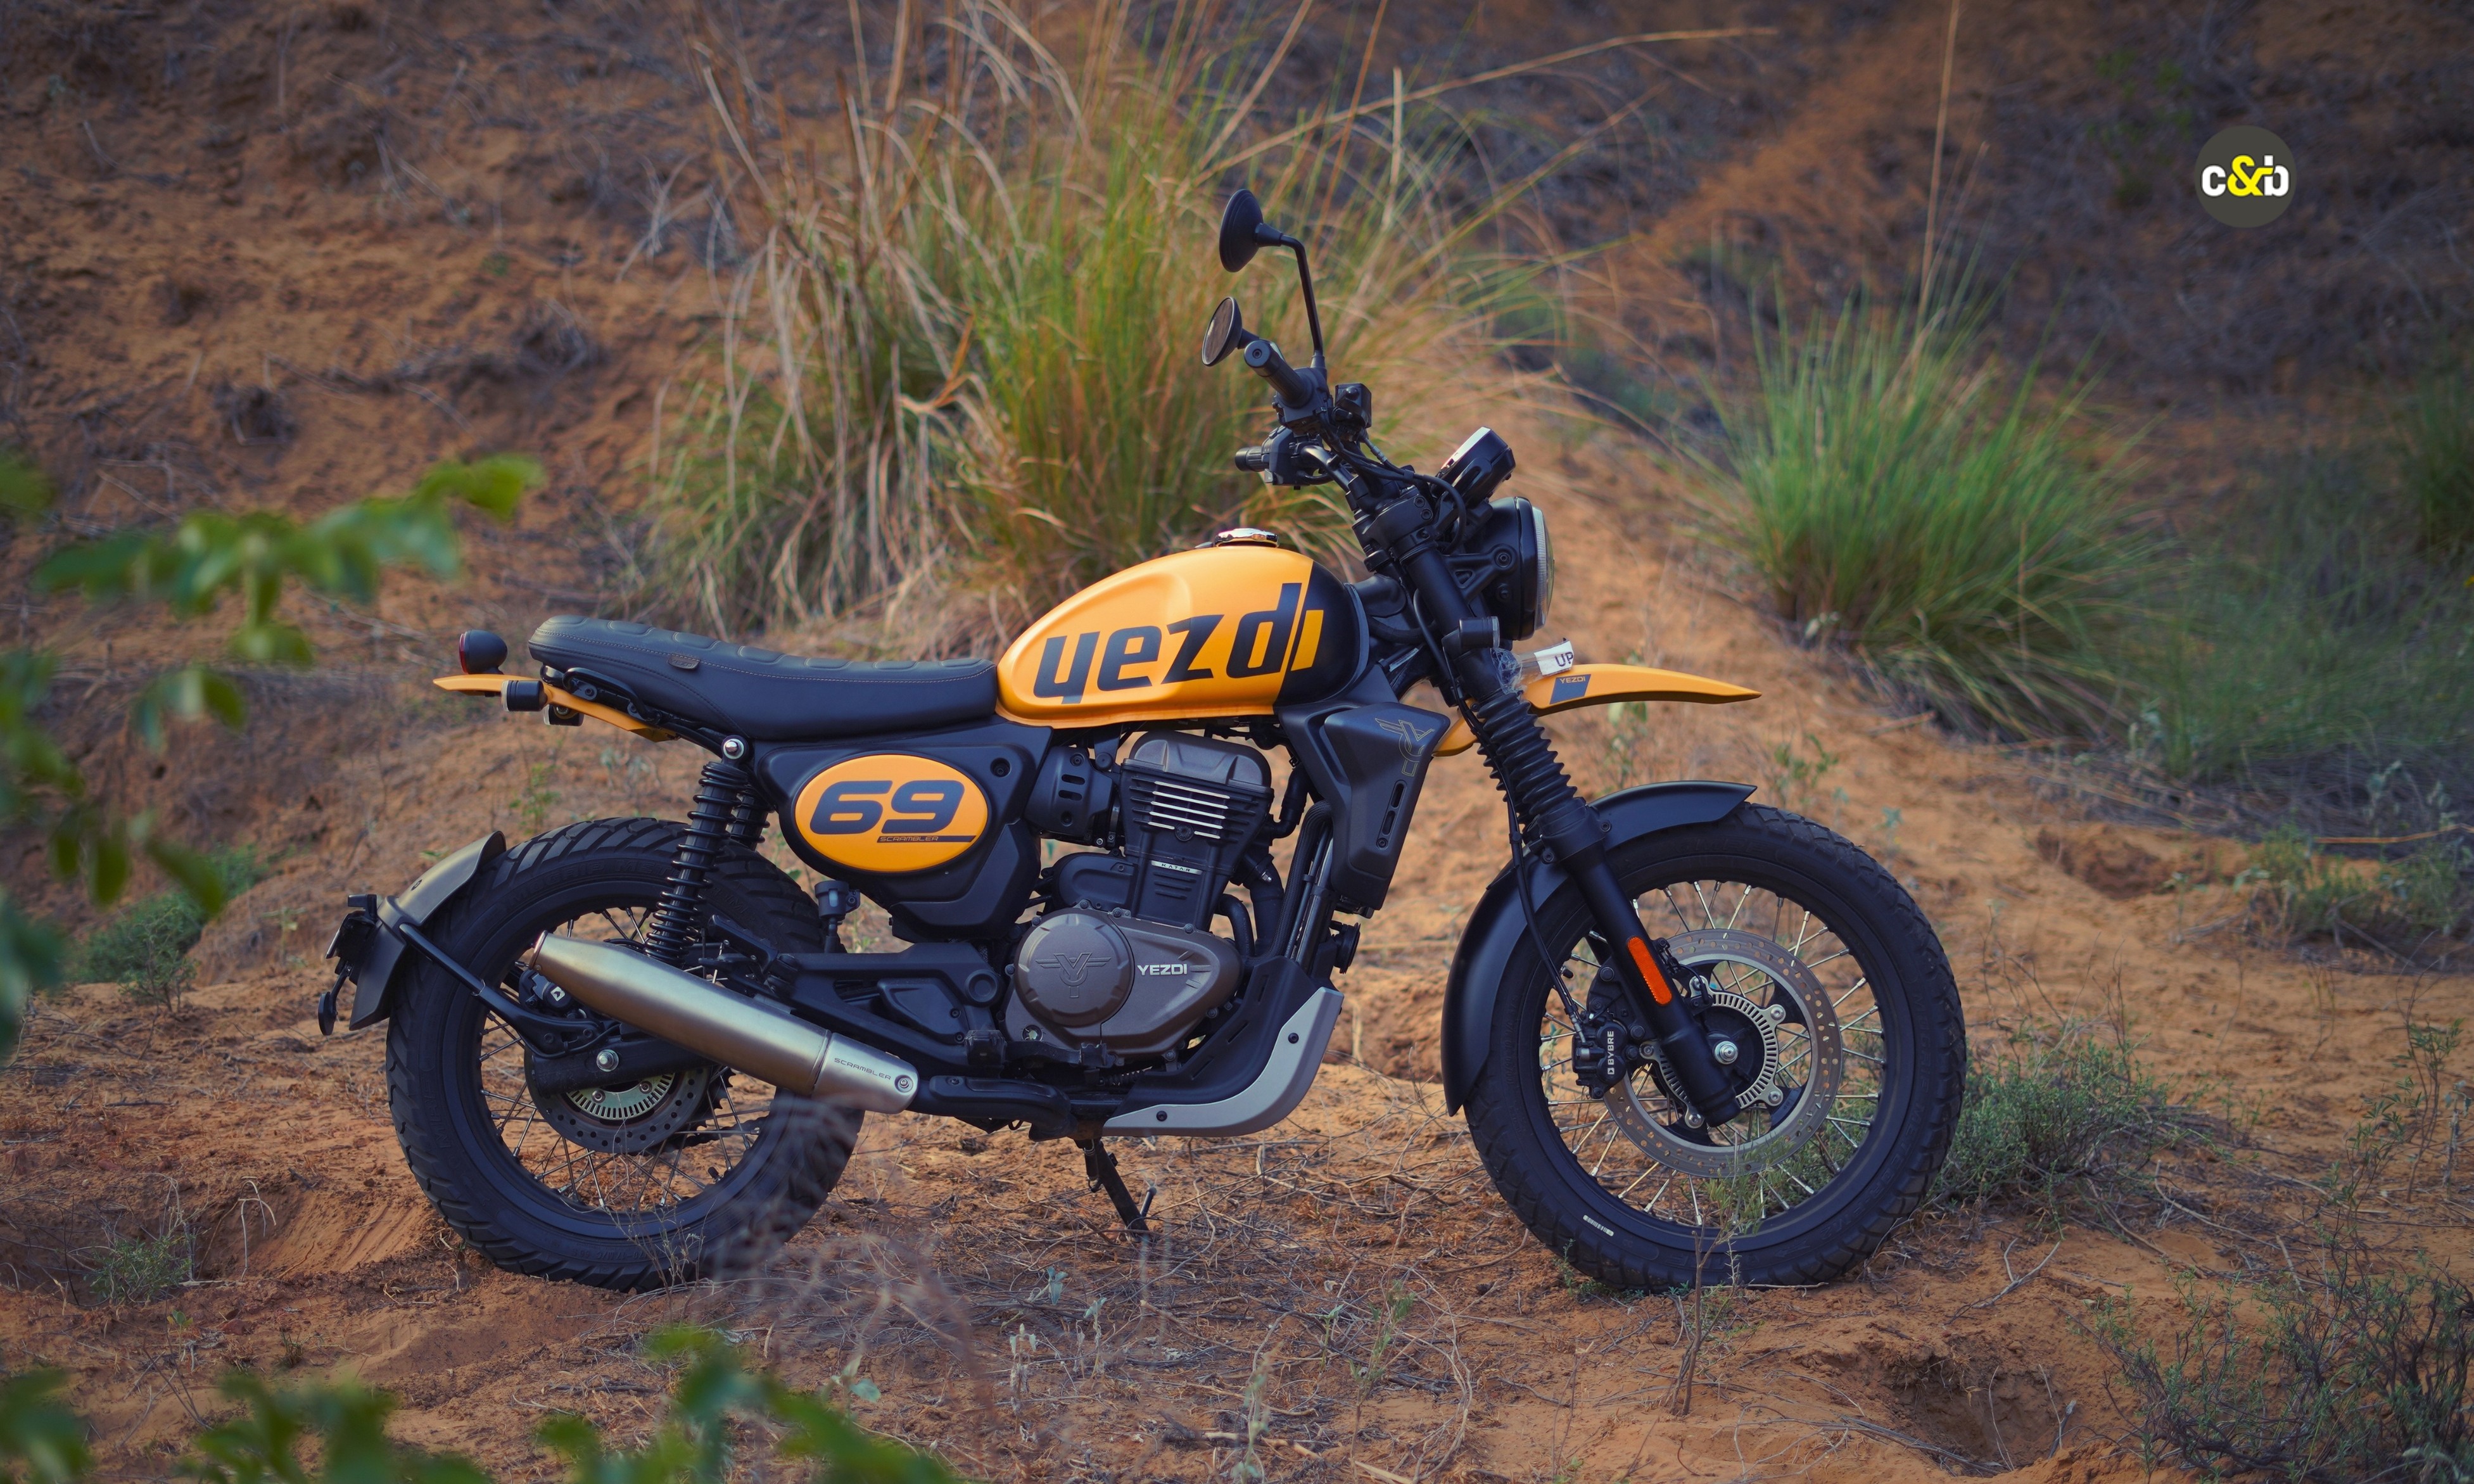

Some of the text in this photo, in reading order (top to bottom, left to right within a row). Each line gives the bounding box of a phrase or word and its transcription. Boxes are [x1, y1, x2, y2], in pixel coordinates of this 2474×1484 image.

[809, 780, 965, 835] 69
[1161, 863, 1191, 872] KATAR
[1137, 963, 1188, 976] YEZDI
[834, 1057, 891, 1080] SCRAMBLER
